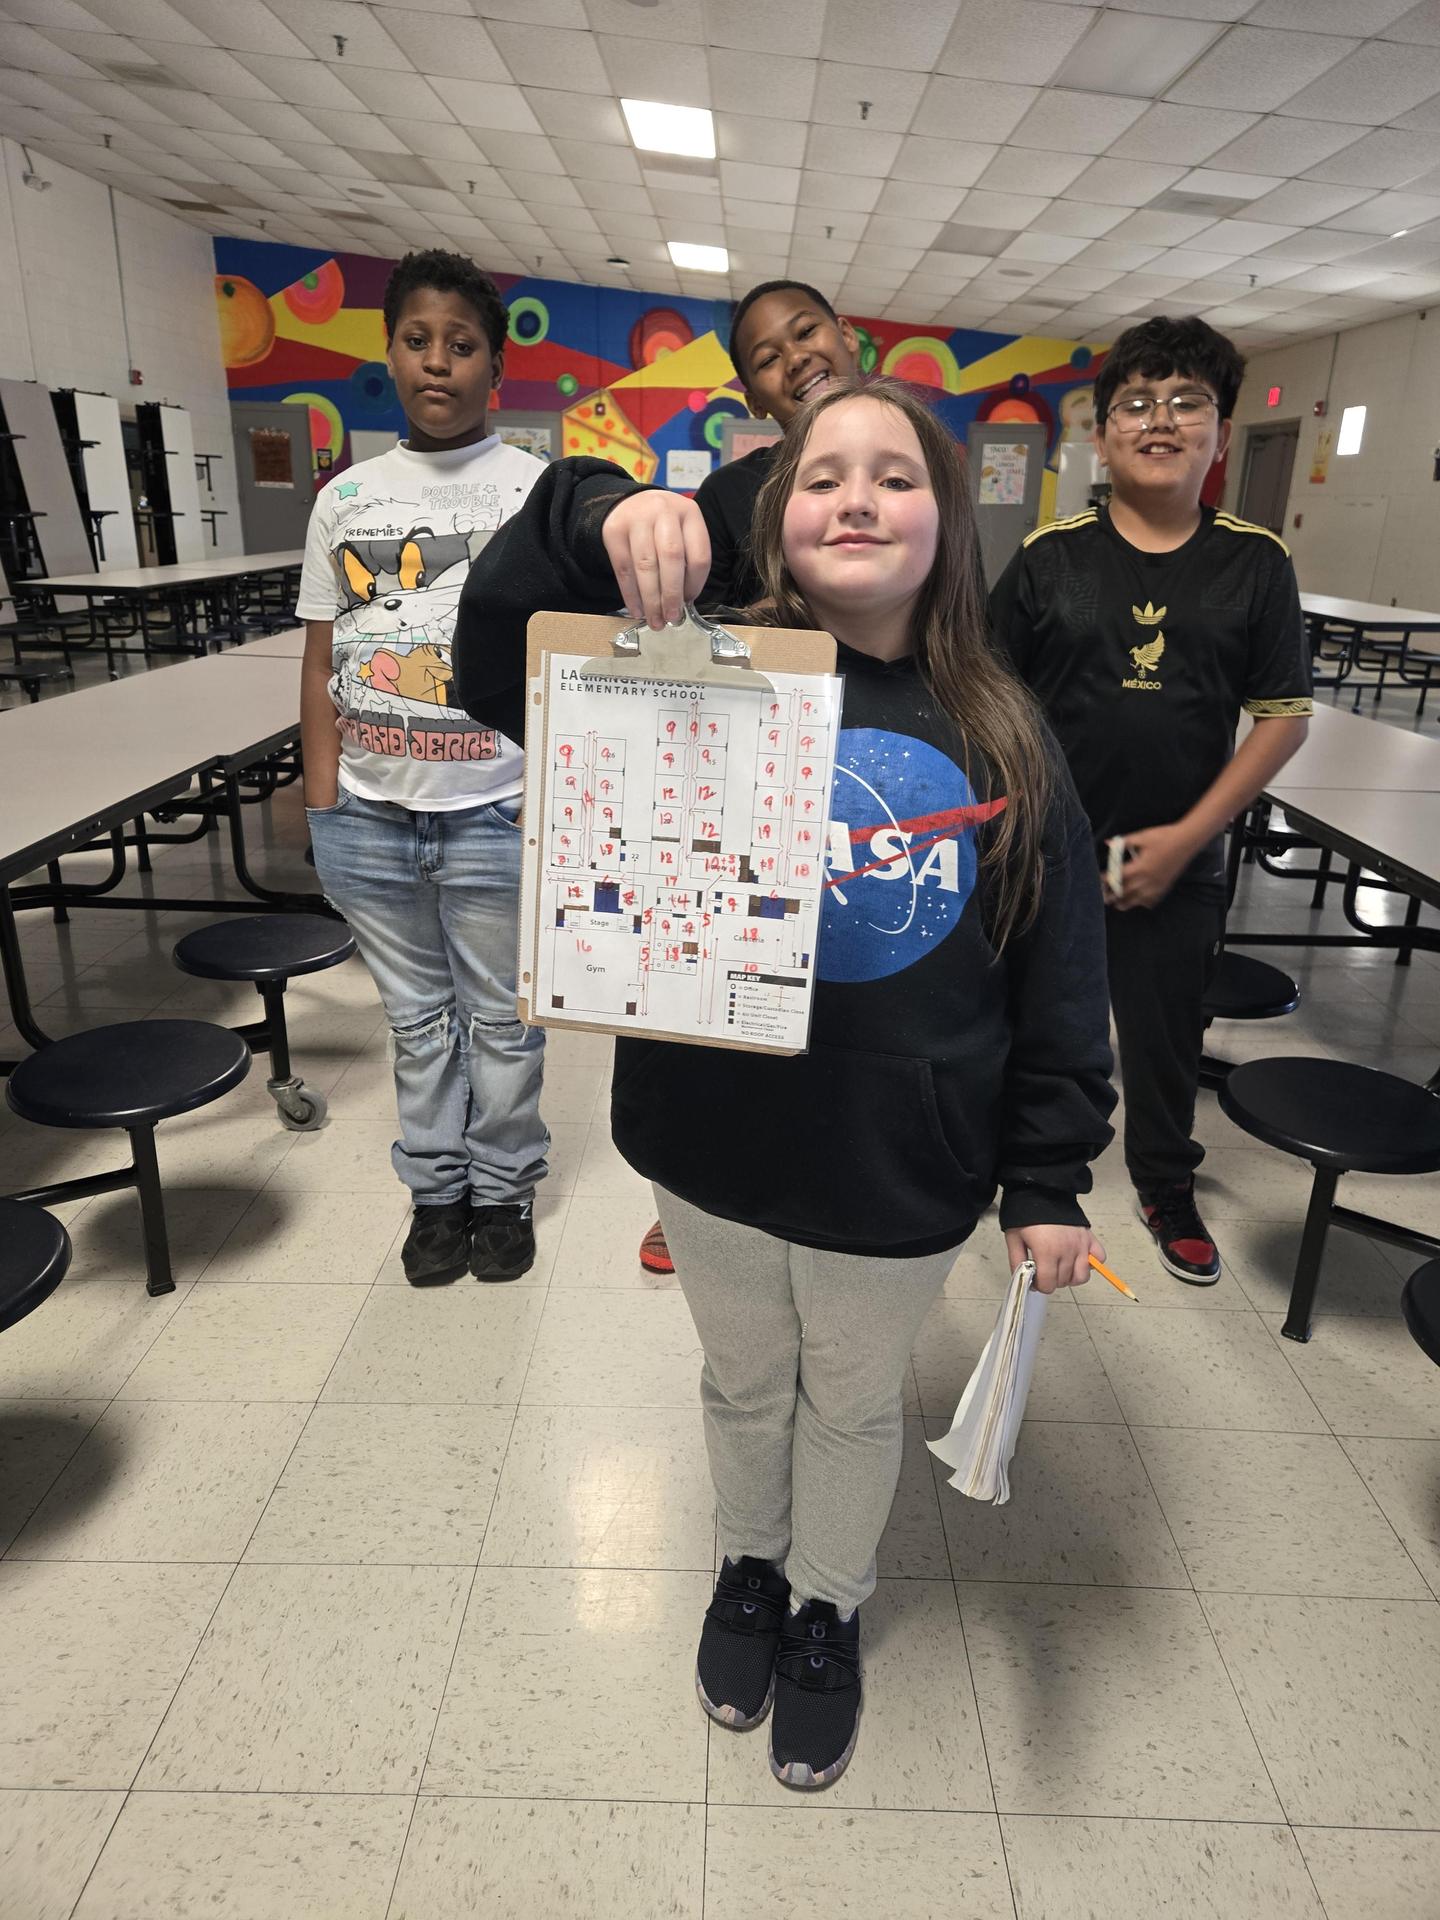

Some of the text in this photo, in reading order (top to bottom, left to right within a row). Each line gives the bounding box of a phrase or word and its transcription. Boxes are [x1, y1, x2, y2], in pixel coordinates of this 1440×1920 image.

[421, 484, 480, 499] DOUBLE
[430, 494, 501, 511] TROUBLE
[346, 523, 404, 537] FRENEMIES
[560, 682, 646, 696] ELEMENTARY
[653, 688, 705, 700] SCHOOL
[1122, 678, 1163, 690] MÉXICO
[359, 721, 407, 757] AND
[410, 729, 497, 762] JERRY
[824, 820, 960, 893] ASA
[590, 918, 610, 928] Stage
[576, 938, 593, 953] 16
[641, 947, 651, 962] 5
[586, 964, 606, 974] Gym
[729, 973, 762, 982] MAP KEY
